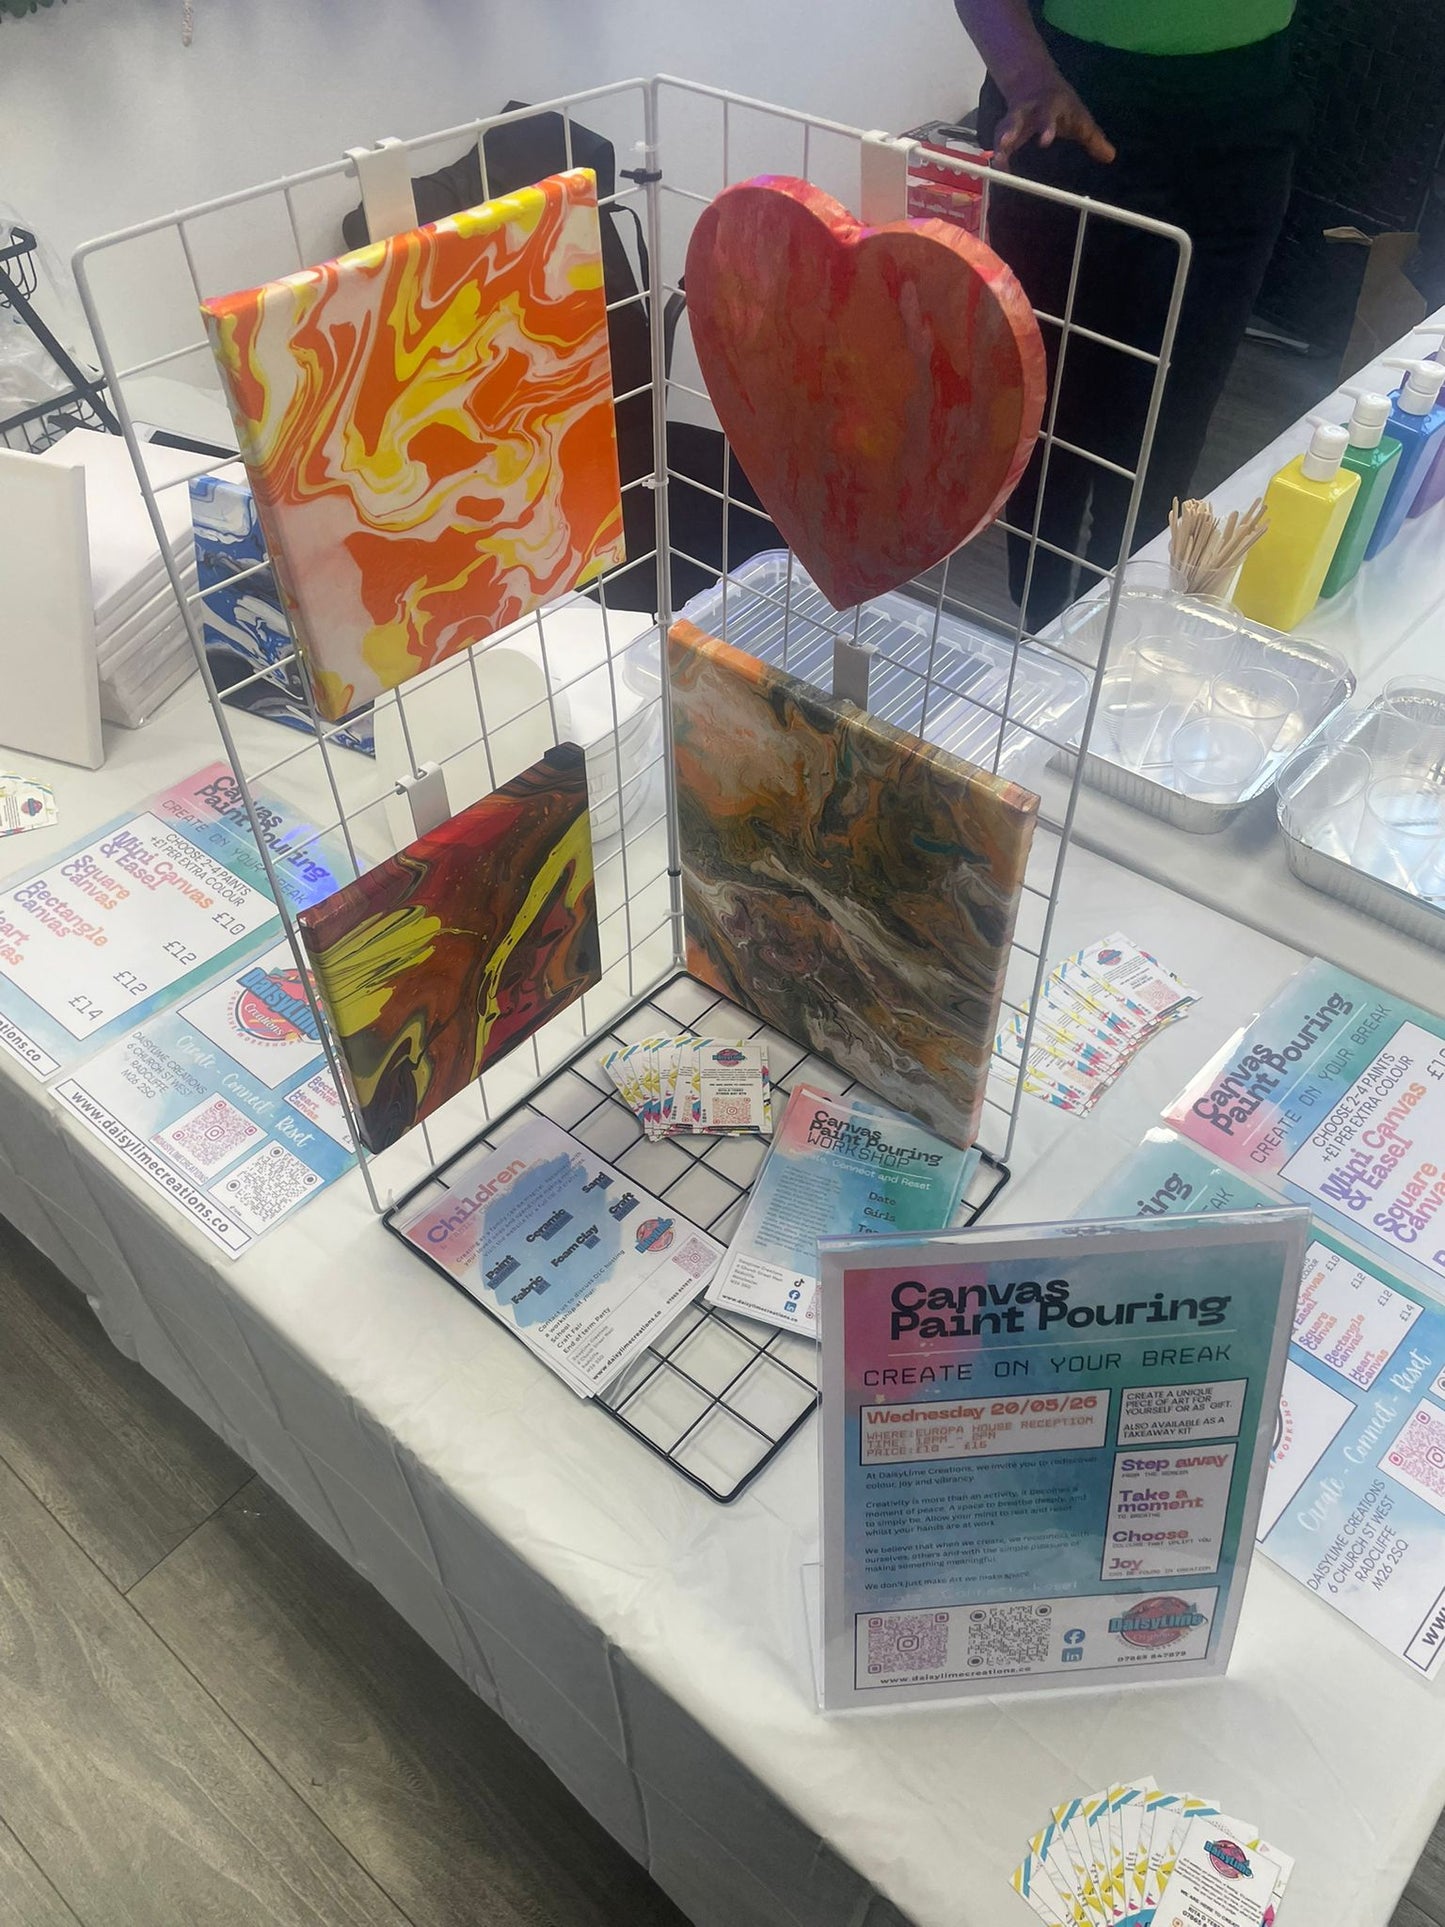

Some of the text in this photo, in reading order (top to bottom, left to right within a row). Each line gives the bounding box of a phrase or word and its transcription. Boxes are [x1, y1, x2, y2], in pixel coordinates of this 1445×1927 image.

[194, 784, 248, 826] Paint
[162, 800, 208, 833] CREATE
[209, 833, 230, 847] ON
[75, 854, 130, 900] Square
[100, 842, 165, 890] & Easel
[113, 831, 214, 909] Mini Canvas
[165, 846, 182, 861] PER
[178, 855, 205, 879] EXTRA
[205, 876, 246, 907] COLOUR
[166, 833, 251, 897] CHOOSE 2-4 PAINTS
[61, 863, 118, 910] Canvas
[13, 889, 71, 938] Canvas
[26, 880, 108, 947] Rectangle
[212, 912, 246, 936] £10
[162, 941, 197, 965] £12
[113, 970, 147, 996] £12
[68, 995, 103, 1021] £14
[244, 1003, 283, 1035] Creations
[131, 1060, 169, 1093] RADCLIFFE
[133, 1047, 164, 1074] CHURCH
[161, 1071, 174, 1082] ST
[167, 1060, 207, 1094] CREATIONS
[1192, 1043, 1273, 1120] Canvas
[1210, 1072, 1280, 1136] Paint
[1267, 992, 1353, 1075] Pouring
[121, 1069, 156, 1099] M26 2SQ
[1250, 1004, 1392, 1164] CREATE ON YOUR BREAK
[1312, 1101, 1355, 1148] CHOOSE
[1362, 1052, 1395, 1087] PAINTS
[1336, 1125, 1358, 1147] PER
[1350, 1097, 1382, 1128] EXTRA
[1375, 1055, 1414, 1097] COLOUR
[222, 1073, 275, 1114] Connect
[275, 1115, 315, 1148] Reset
[815, 1110, 882, 1140] Canvas
[807, 1131, 910, 1168] WORKSHOP
[810, 1119, 943, 1167] Paint Pouring
[1319, 1082, 1428, 1201] Mini Canvas
[71, 1091, 229, 1234] www.daisylimecreations.co
[833, 1160, 931, 1191] Connect and Reset
[1347, 1130, 1414, 1211] & Easel
[427, 1160, 526, 1243] Children
[608, 1192, 634, 1215] Craft
[869, 1191, 896, 1206] Date
[1374, 1162, 1438, 1233] Square
[1393, 1172, 1445, 1243] Canva
[526, 1208, 566, 1243] Ceramic
[551, 1242, 579, 1268] Foam
[576, 1225, 599, 1246] Clay
[485, 1255, 514, 1281] Paint
[1350, 1273, 1366, 1290] £12
[511, 1275, 544, 1304] Fabric
[891, 1277, 1069, 1312] Canvas
[1377, 1289, 1393, 1307] £12
[891, 1293, 1232, 1340] Paint Pouring
[1299, 1312, 1329, 1345] Square
[1400, 1304, 1415, 1322] £14
[1306, 1315, 1337, 1351] Canvas
[1324, 1314, 1365, 1363] Rectangle
[1333, 1333, 1364, 1368] Canvas
[864, 1344, 1231, 1386] CREATE ON YOUR BREAK
[1349, 1350, 1375, 1380] Heart
[1359, 1349, 1389, 1385] Canvas
[1125, 1406, 1171, 1415] YOURSELF
[1175, 1404, 1190, 1412] OR
[1192, 1403, 1205, 1411] AS
[1126, 1387, 1212, 1400] CREATE UNIQUE
[1126, 1400, 1153, 1408] PIECE
[1155, 1398, 1168, 1406] OF
[1192, 1395, 1211, 1403] FOR
[867, 1405, 985, 1424] Wednesday
[1020, 1416, 1093, 1429] RECEPTION
[1123, 1422, 1148, 1430] ALSO
[1151, 1418, 1199, 1429] AVAILABLE
[1123, 1427, 1191, 1438] TAKEAWAY KIT
[1297, 1348, 1432, 1532] Create Connect Reset
[879, 1469, 926, 1478] DaisyLime
[1121, 1454, 1228, 1471] Step away
[1117, 1497, 1204, 1512] moment
[1119, 1488, 1188, 1502] Take a
[1112, 1530, 1189, 1542] Choose
[1307, 1478, 1386, 1591] DAISYLIME CREATIONS
[1328, 1495, 1395, 1594] 6 CHURCH ST WEST
[1109, 1558, 1143, 1571] Joy
[1354, 1525, 1397, 1582] RADCLIFFE
[1371, 1538, 1409, 1591] M26 2SQ
[1108, 1611, 1205, 1633] DaisyLime
[880, 1666, 1031, 1684] www.daisylimecreations.co
